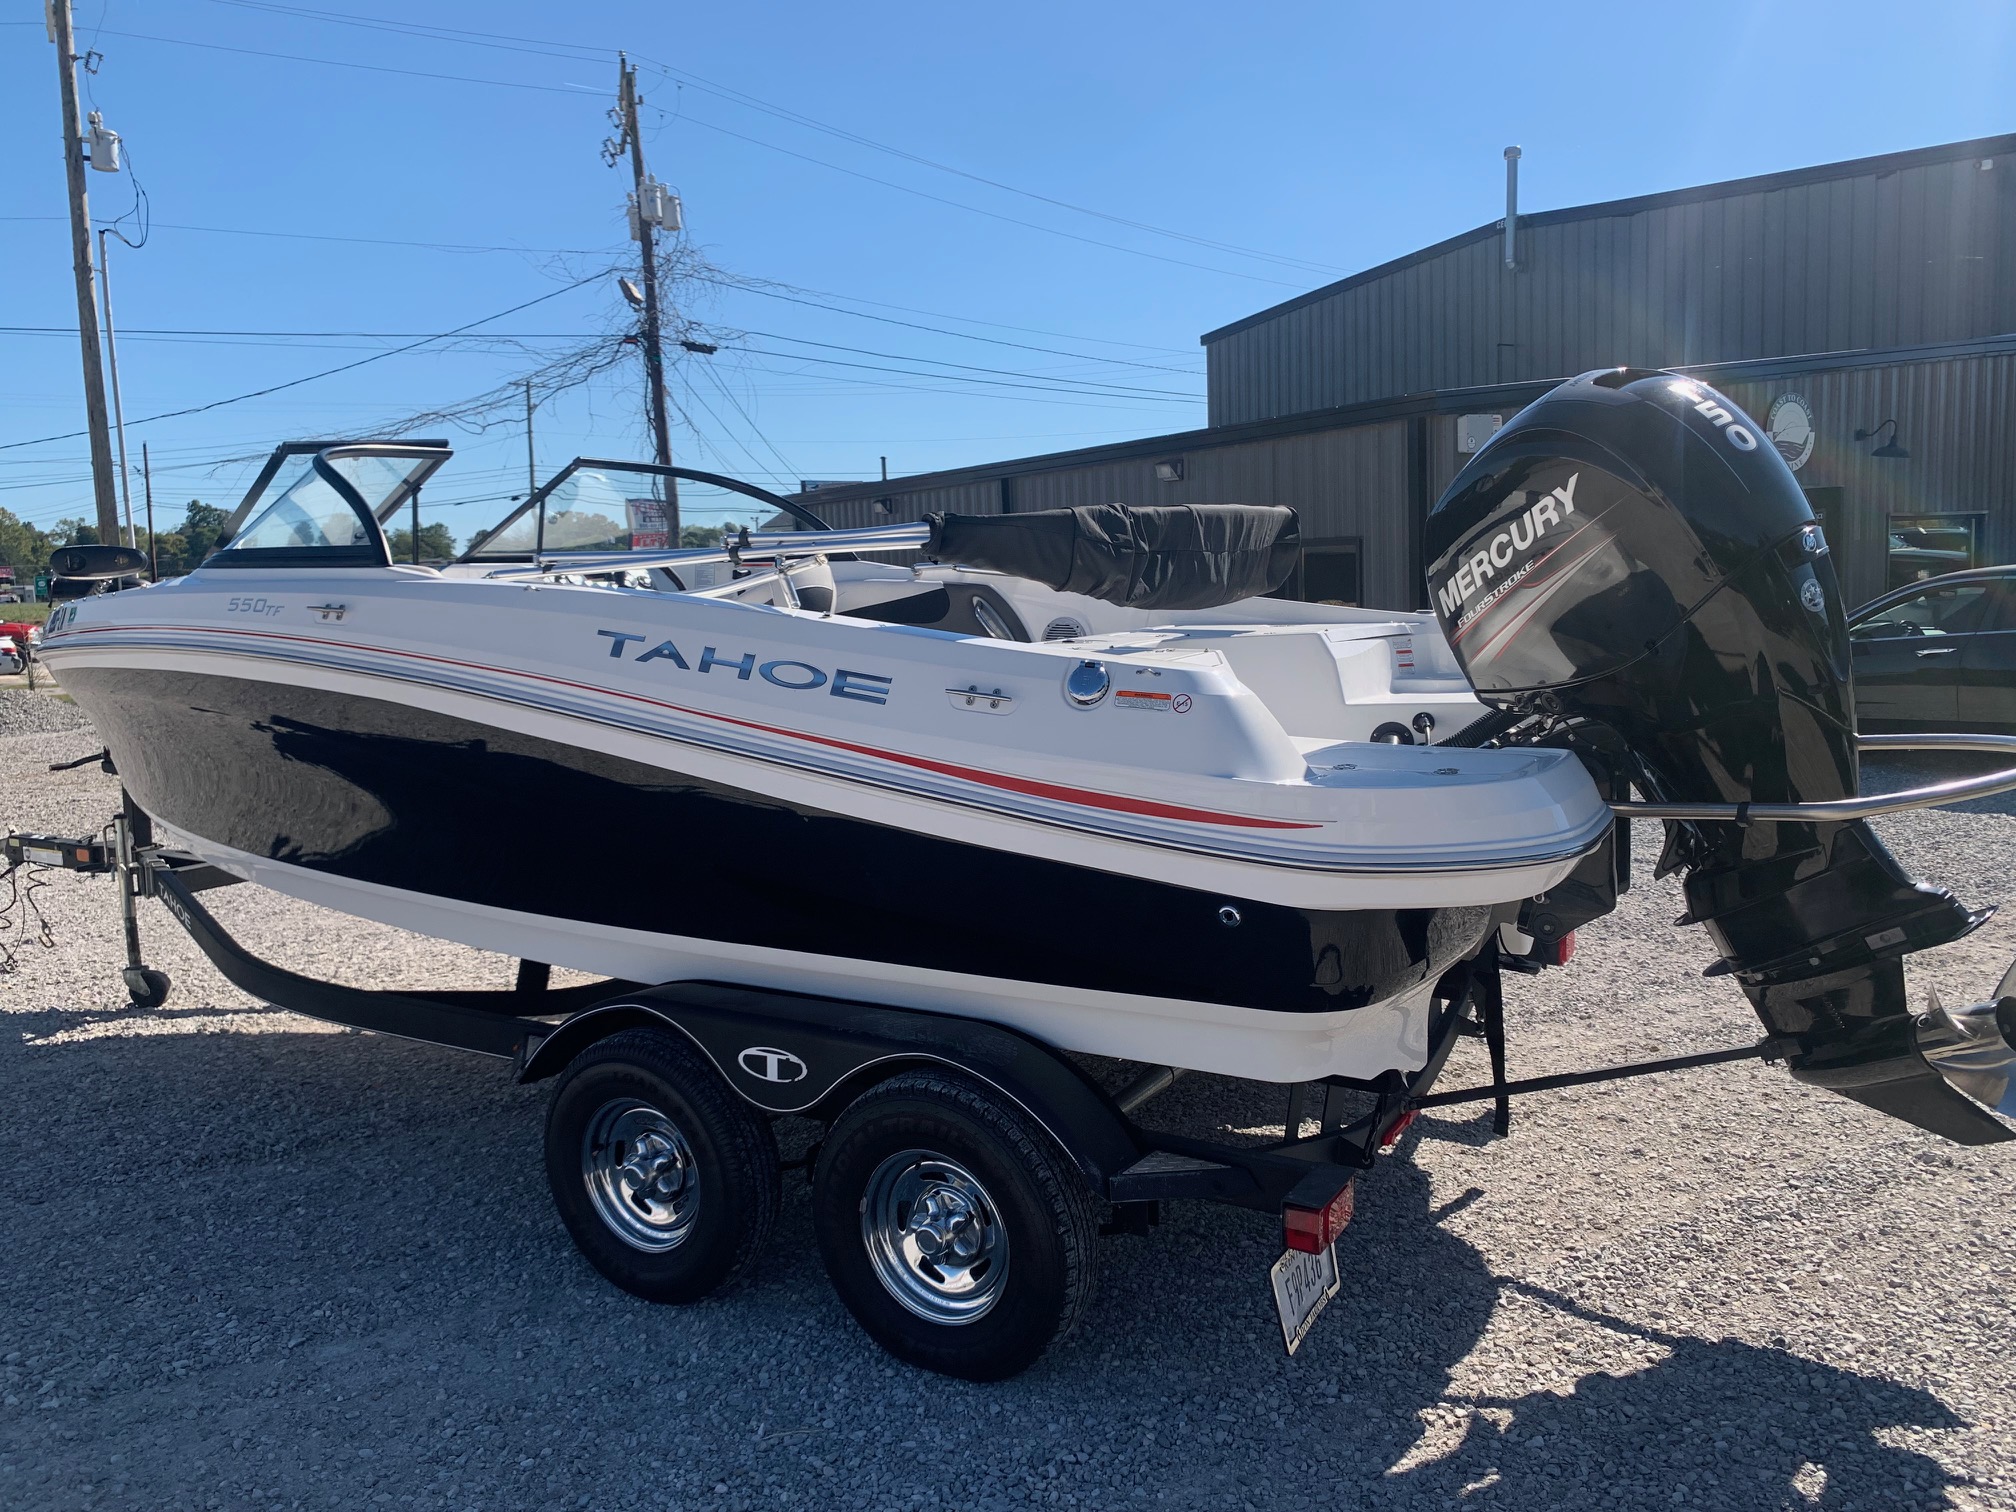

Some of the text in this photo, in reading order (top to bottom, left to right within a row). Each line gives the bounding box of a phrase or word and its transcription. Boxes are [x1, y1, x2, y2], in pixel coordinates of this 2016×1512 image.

[1438, 472, 1579, 618] MERCURY
[1457, 559, 1536, 628] FOURSTROKE
[597, 629, 893, 705] TAHOE
[158, 882, 192, 931] TAHOE
